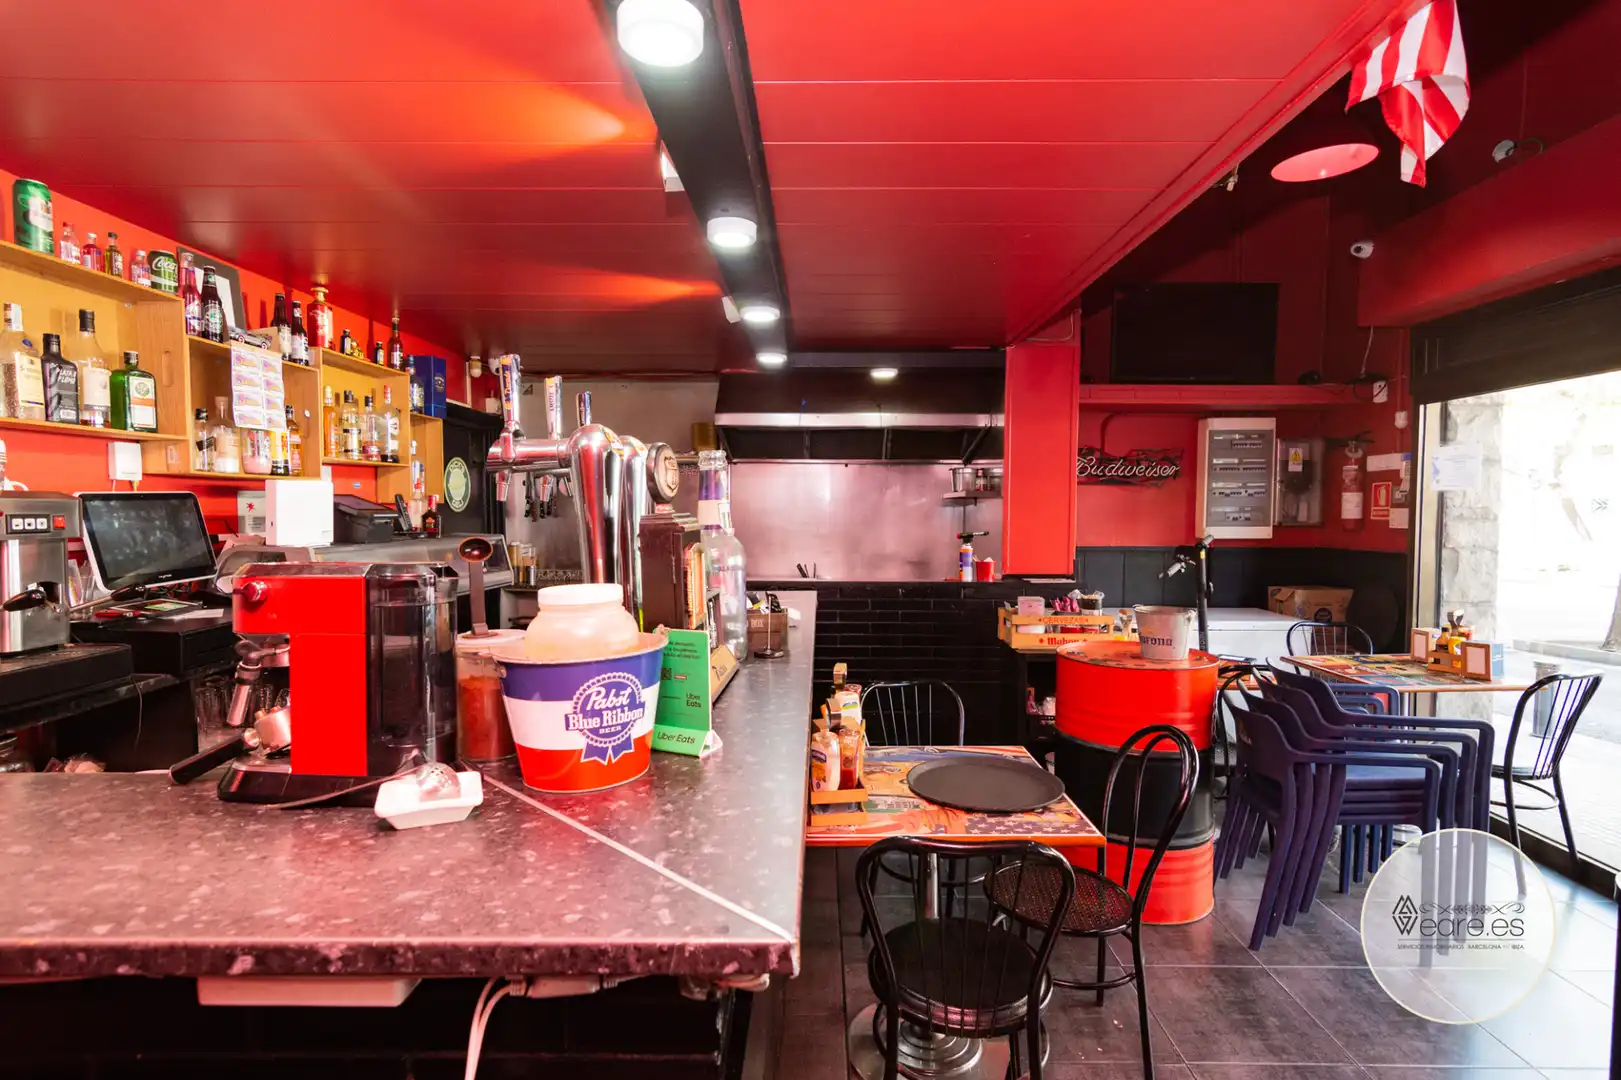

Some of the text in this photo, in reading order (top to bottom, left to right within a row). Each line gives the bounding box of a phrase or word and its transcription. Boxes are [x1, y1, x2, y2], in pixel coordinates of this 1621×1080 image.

[1077, 456, 1180, 477] Budweiser
[1139, 634, 1173, 647] orona
[585, 686, 633, 710] Pabst
[686, 692, 700, 700] Uber
[686, 700, 701, 708] Eats
[568, 707, 644, 730] Blue Ribbon
[599, 726, 622, 734] BEER
[657, 732, 695, 744] Uber Eats
